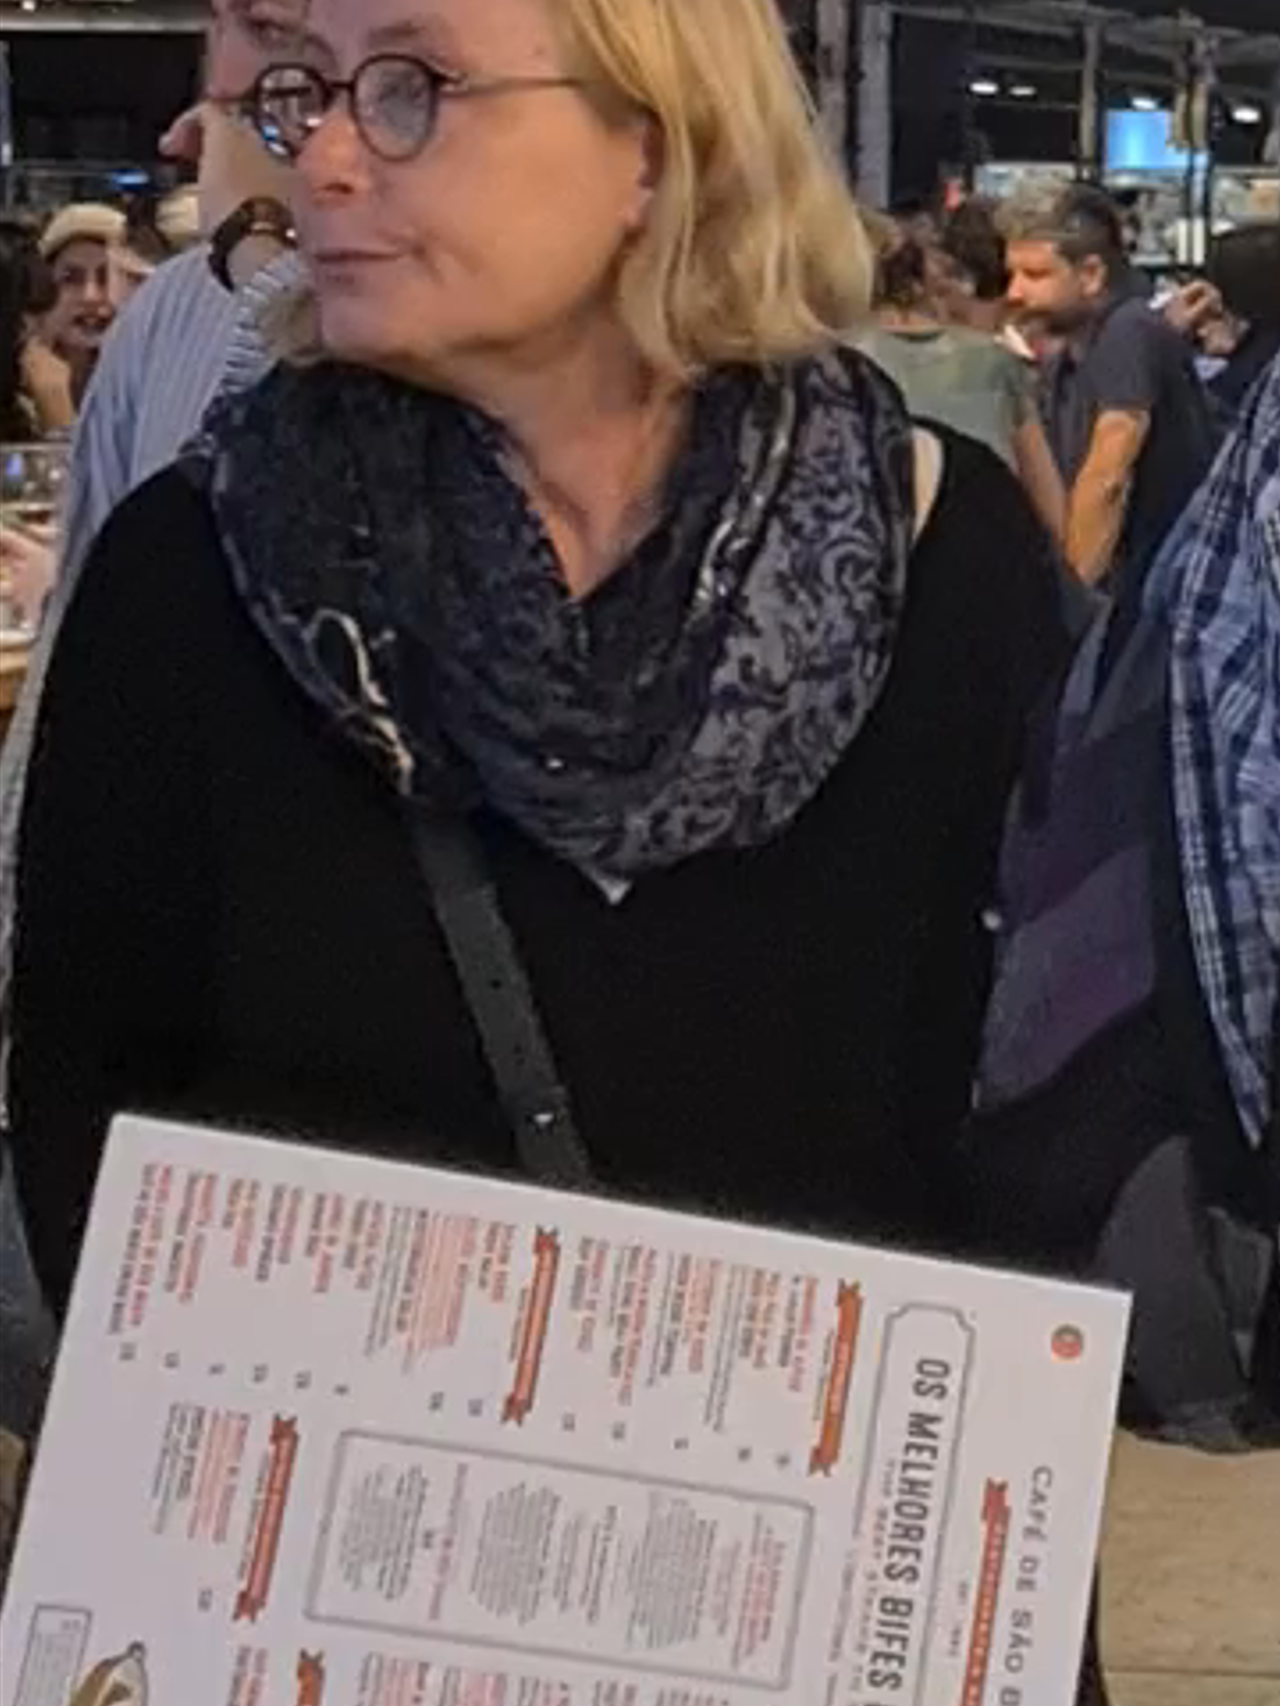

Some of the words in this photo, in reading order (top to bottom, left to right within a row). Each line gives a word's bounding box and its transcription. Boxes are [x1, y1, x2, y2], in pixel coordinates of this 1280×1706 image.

[910, 1356, 950, 1400] OS
[882, 1410, 941, 1584] MELHORES
[1015, 1555, 1040, 1592] DE
[867, 1595, 914, 1691] BIFES
[1003, 1608, 1034, 1674] SÃO
